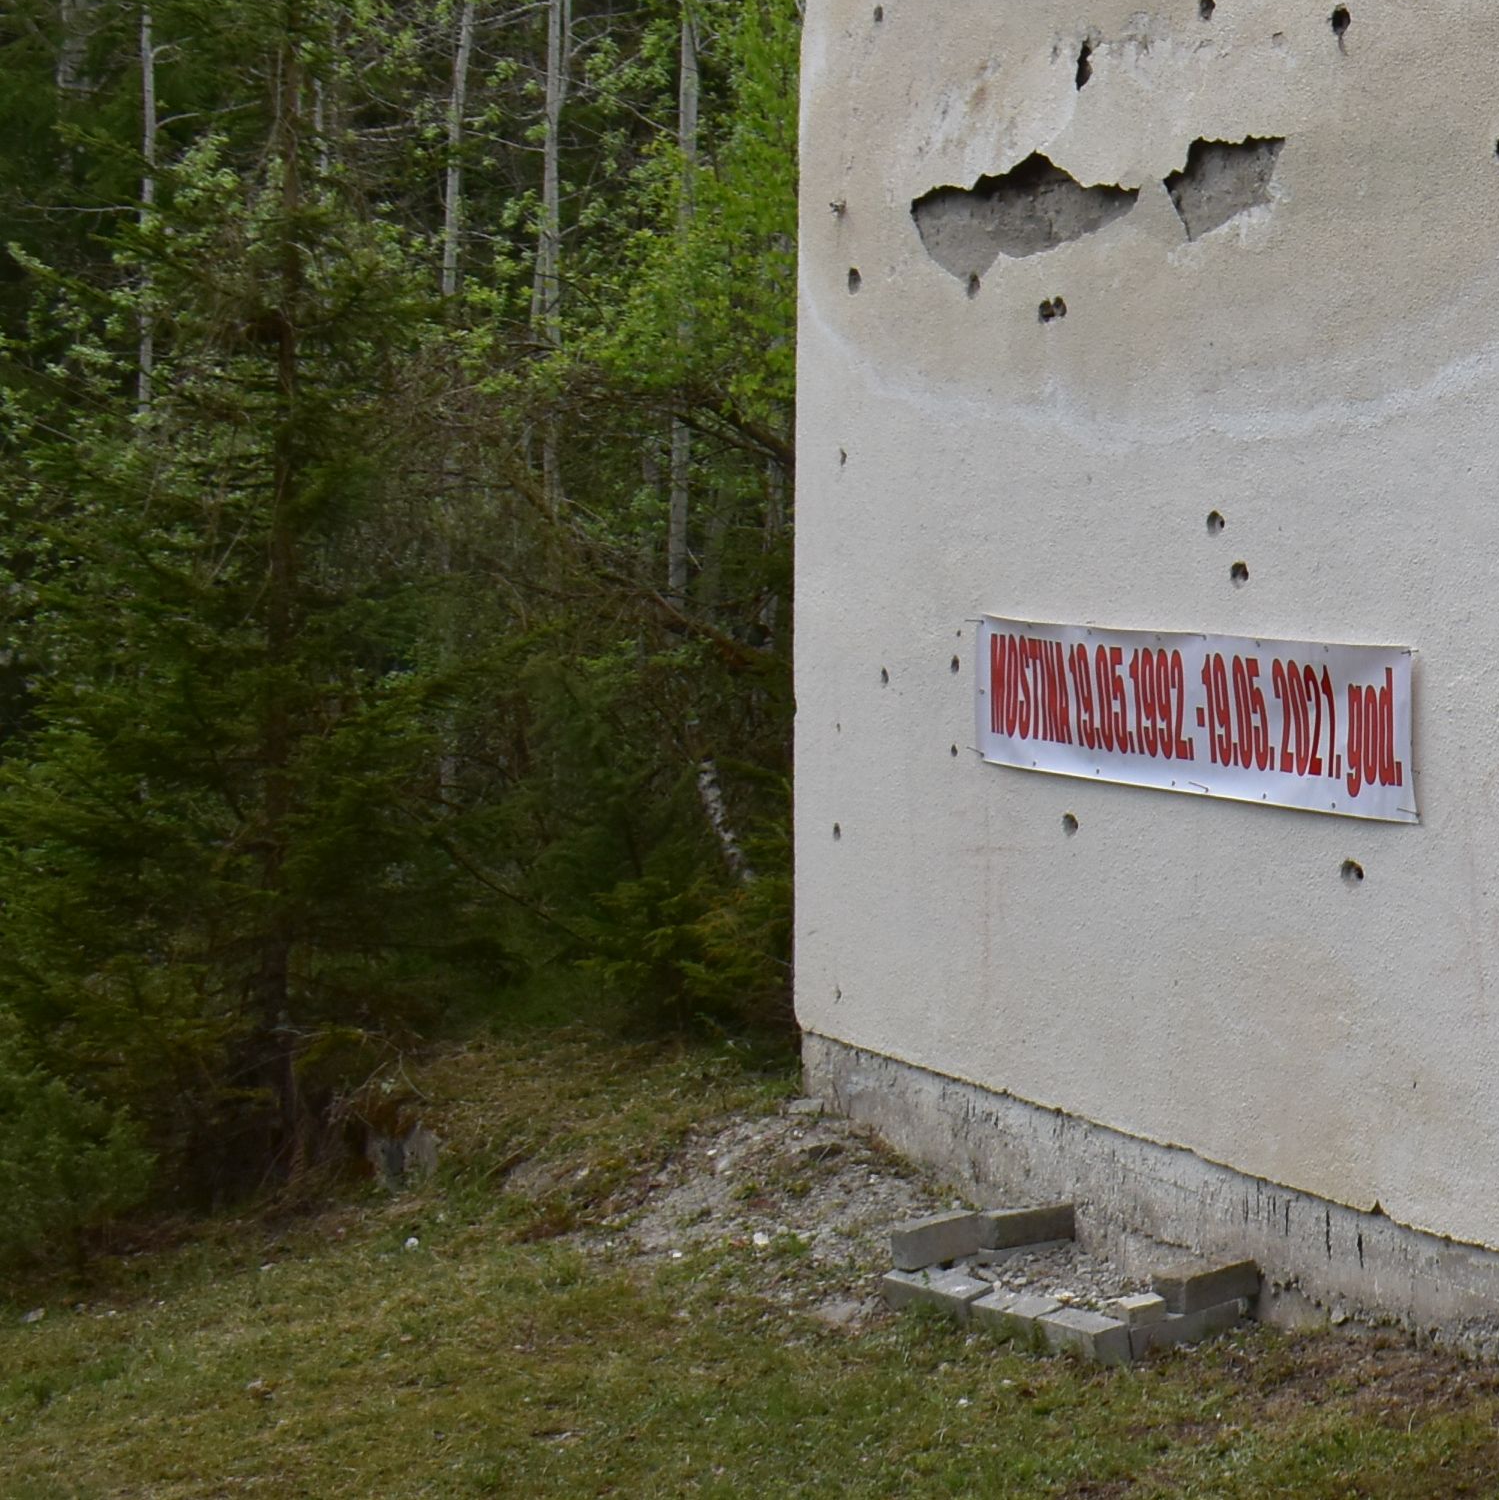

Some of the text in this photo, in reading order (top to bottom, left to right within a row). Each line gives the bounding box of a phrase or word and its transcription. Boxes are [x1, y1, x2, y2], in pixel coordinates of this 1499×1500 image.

[990, 633, 1073, 745] MOSTINA
[1068, 643, 1195, 761] 19.05.1992.
[1346, 667, 1403, 798] god.
